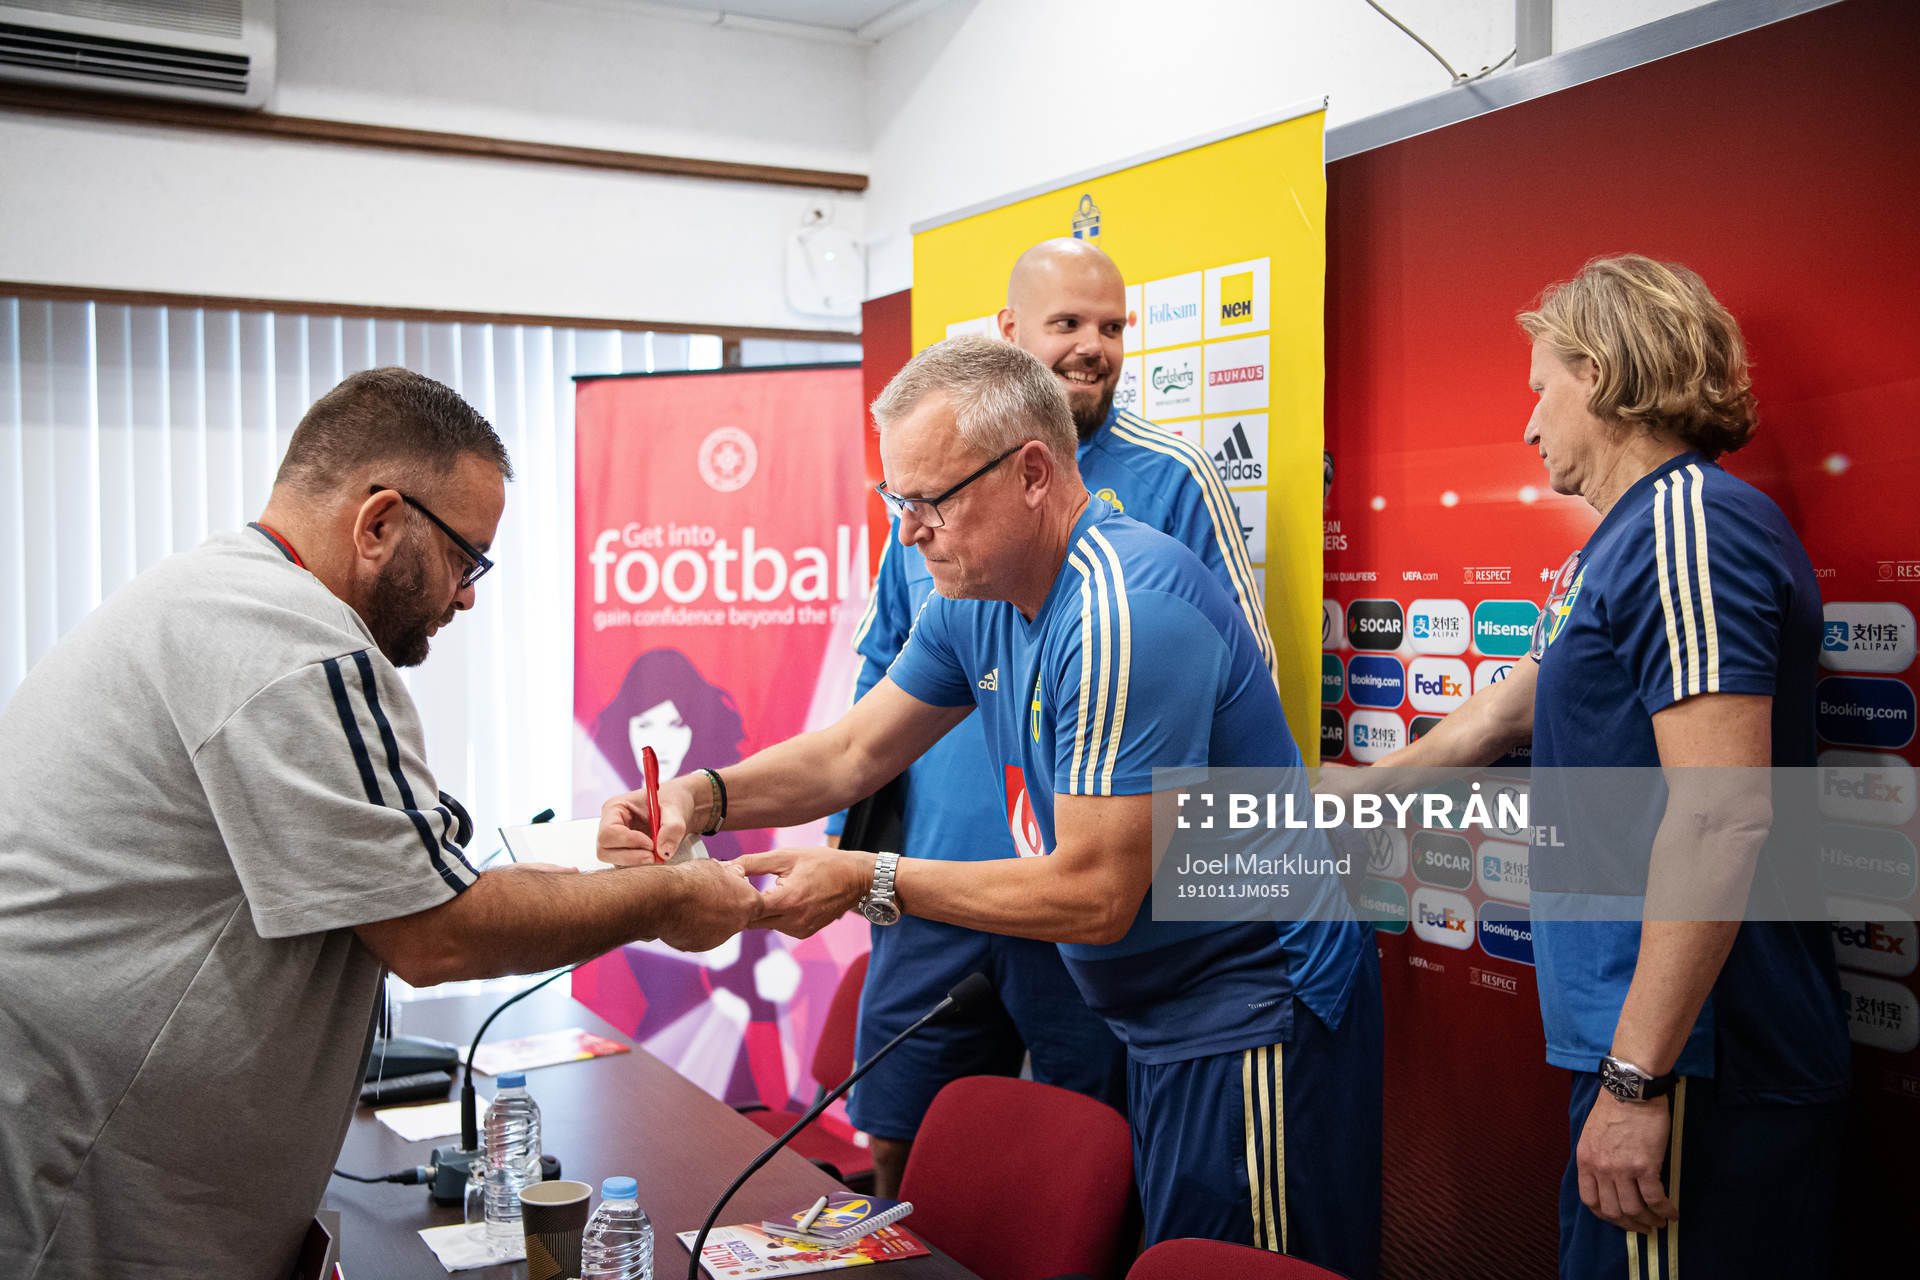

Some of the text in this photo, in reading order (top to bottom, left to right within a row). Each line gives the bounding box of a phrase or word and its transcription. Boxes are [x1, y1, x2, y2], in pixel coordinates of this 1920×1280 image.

[1149, 303, 1198, 326] Folksam
[1152, 363, 1194, 392] Carlsberg
[1208, 365, 1264, 386] BAUHAUS
[1217, 459, 1262, 481] didas
[622, 520, 717, 548] Get into
[588, 523, 870, 605] football
[1339, 571, 1377, 582] QUALIFIERS
[1402, 570, 1439, 582] UEFA.com
[1475, 570, 1512, 581] RESPECT
[592, 606, 631, 632] gain
[632, 605, 726, 627] confidence
[727, 605, 796, 630] beyond
[797, 605, 828, 625] the
[1359, 617, 1401, 633] SOCAR
[1431, 615, 1461, 631] 支付宝
[1852, 623, 1899, 642] 支付宝
[1853, 642, 1898, 652] ALIPAY
[1351, 673, 1401, 689] Booking.com
[1414, 673, 1463, 697] FedEx
[1819, 701, 1908, 721] Booking.com
[1370, 727, 1397, 743] 支付宝
[1371, 741, 1397, 749] ALIPAY
[1823, 768, 1904, 805] FedEx
[1425, 850, 1471, 872] SOCAR
[1820, 846, 1910, 876] Hisense
[1504, 875, 1529, 886] ALIPA
[1418, 902, 1467, 934] FedEx
[1482, 920, 1532, 942] Booking.co
[1409, 955, 1446, 973] UEFA.com
[1481, 973, 1518, 991] RESPECT
[1855, 995, 1902, 1021] 支付宝
